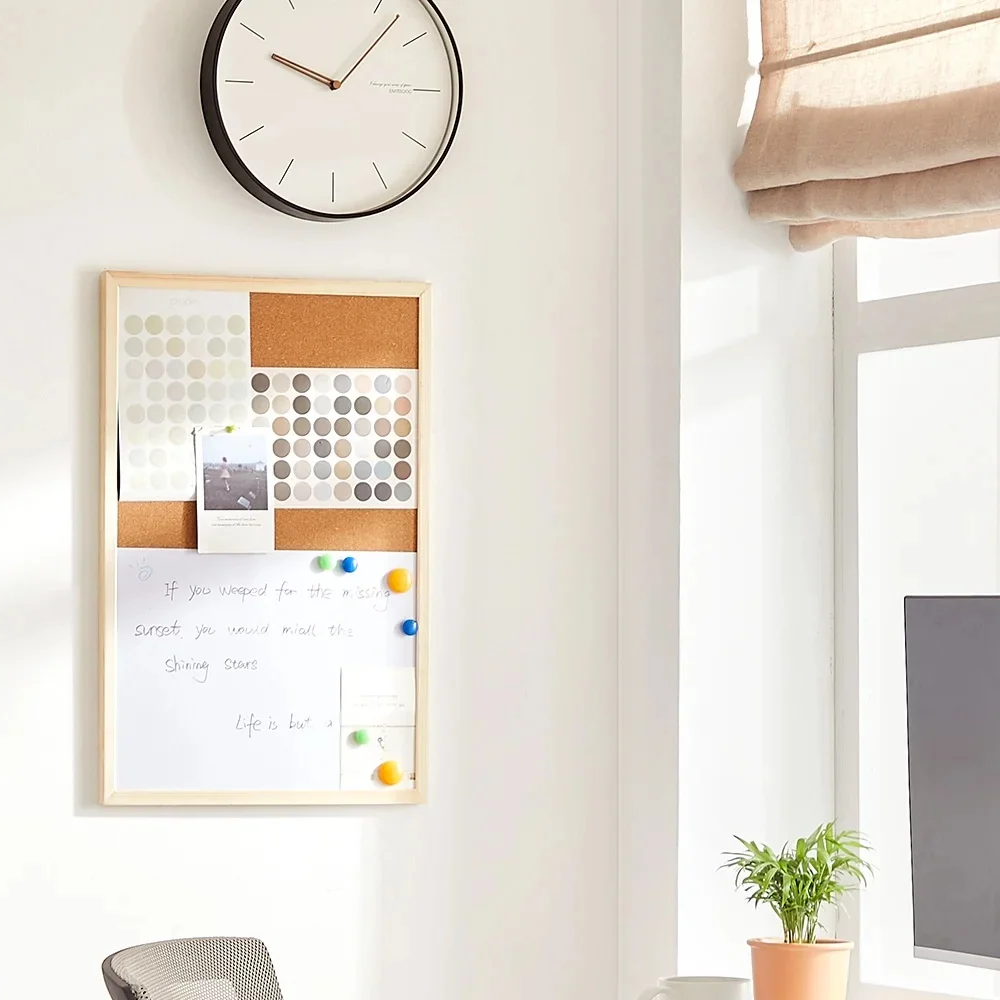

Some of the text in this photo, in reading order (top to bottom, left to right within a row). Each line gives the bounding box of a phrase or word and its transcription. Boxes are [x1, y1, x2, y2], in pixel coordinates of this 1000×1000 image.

[165, 580, 179, 600] If
[189, 585, 211, 601] you
[275, 581, 298, 601] for
[307, 583, 332, 599] the
[342, 585, 391, 612] missing
[195, 624, 216, 640] you
[228, 623, 270, 636] would
[328, 624, 353, 637] the
[268, 716, 278, 730] is
[289, 713, 312, 729] but
